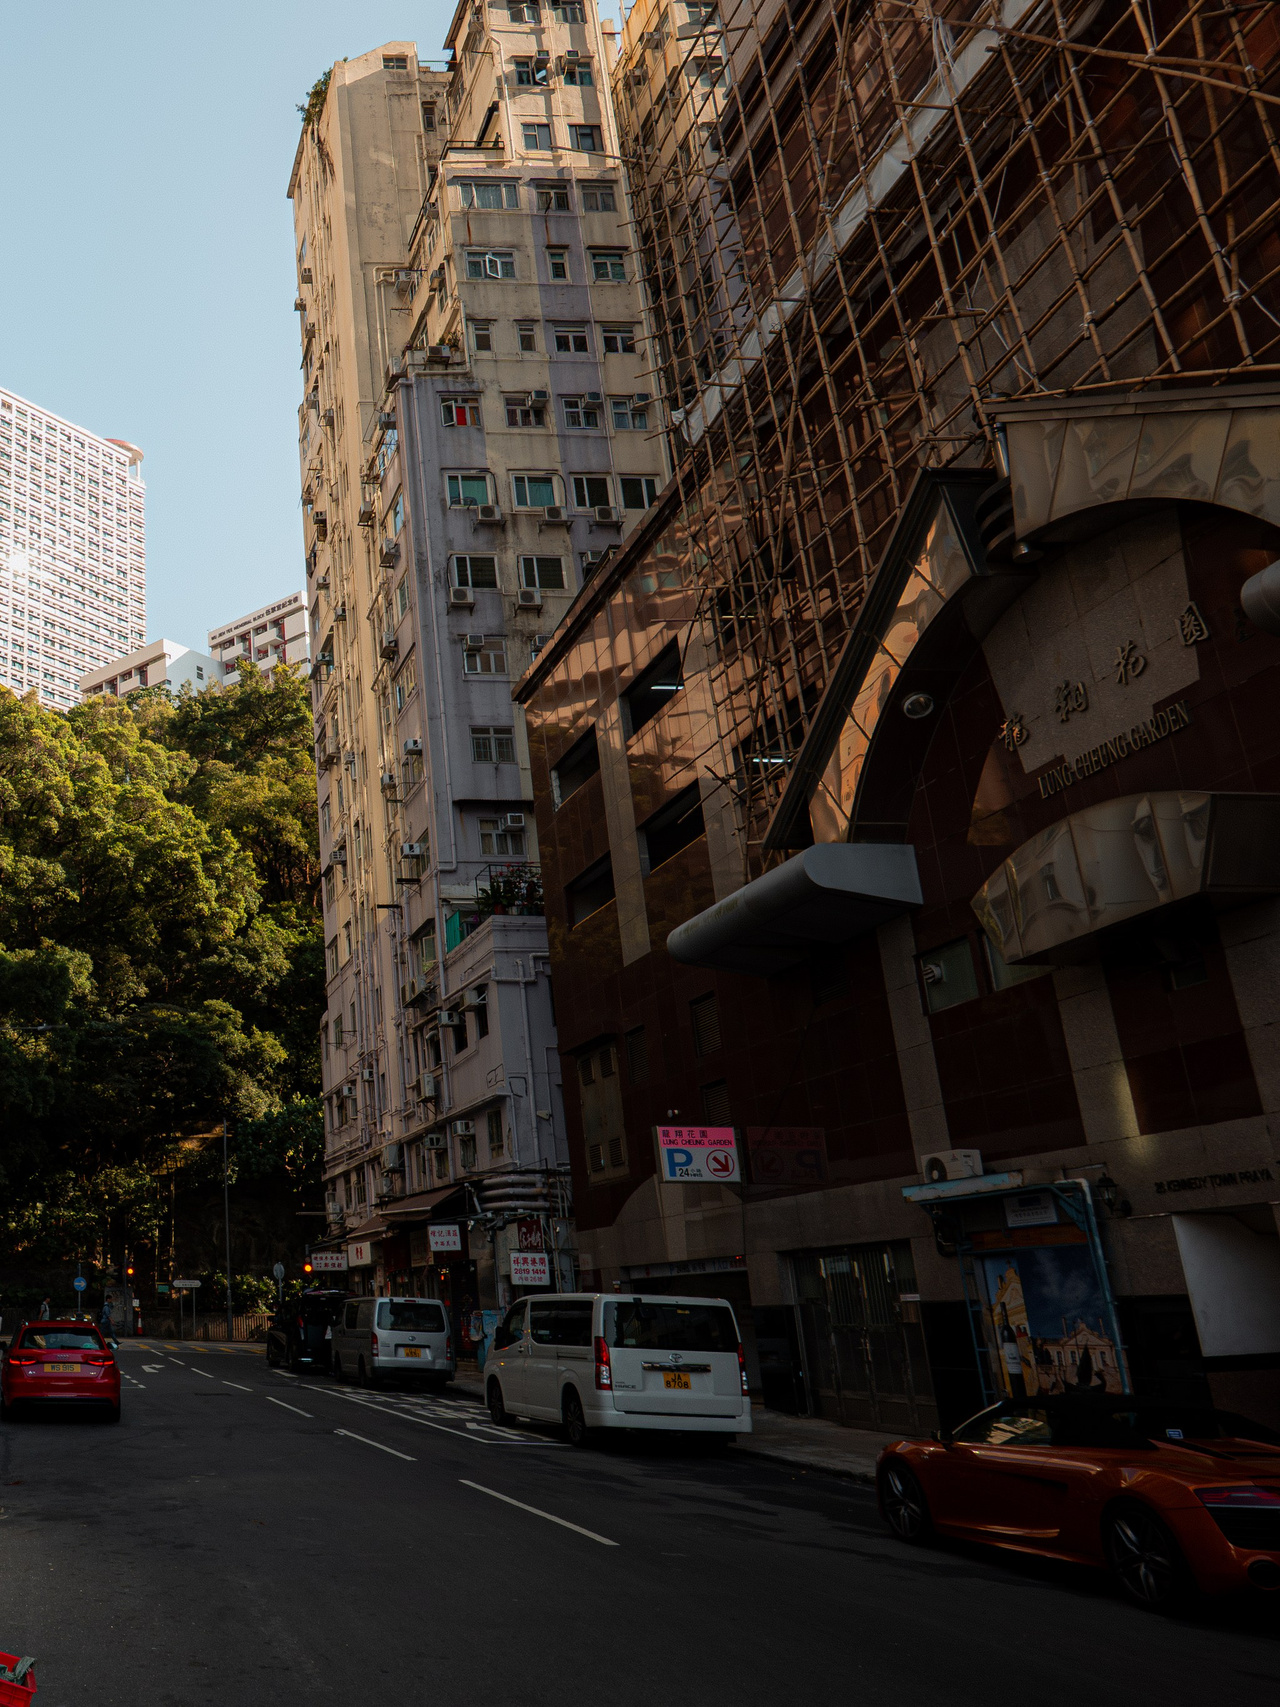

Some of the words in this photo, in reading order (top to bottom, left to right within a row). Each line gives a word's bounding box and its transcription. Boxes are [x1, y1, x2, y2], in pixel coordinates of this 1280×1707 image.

[233, 620, 252, 631] MEMORIAL
[253, 612, 265, 622] BLOCK
[999, 600, 1211, 752] 龍翔花園
[1037, 762, 1074, 800] LUNG
[1073, 733, 1129, 781] CHEUNG
[1127, 699, 1192, 752] GARDEN
[662, 1130, 708, 1138] 龍翔花園
[666, 1148, 693, 1177] P
[678, 1168, 690, 1177] 24
[1166, 1176, 1207, 1192] KENNEDY
[1207, 1172, 1238, 1188] TOWN
[1239, 1168, 1274, 1184] PRAYA
[666, 1380, 689, 1389] 8708
[671, 1374, 682, 1382] JA
